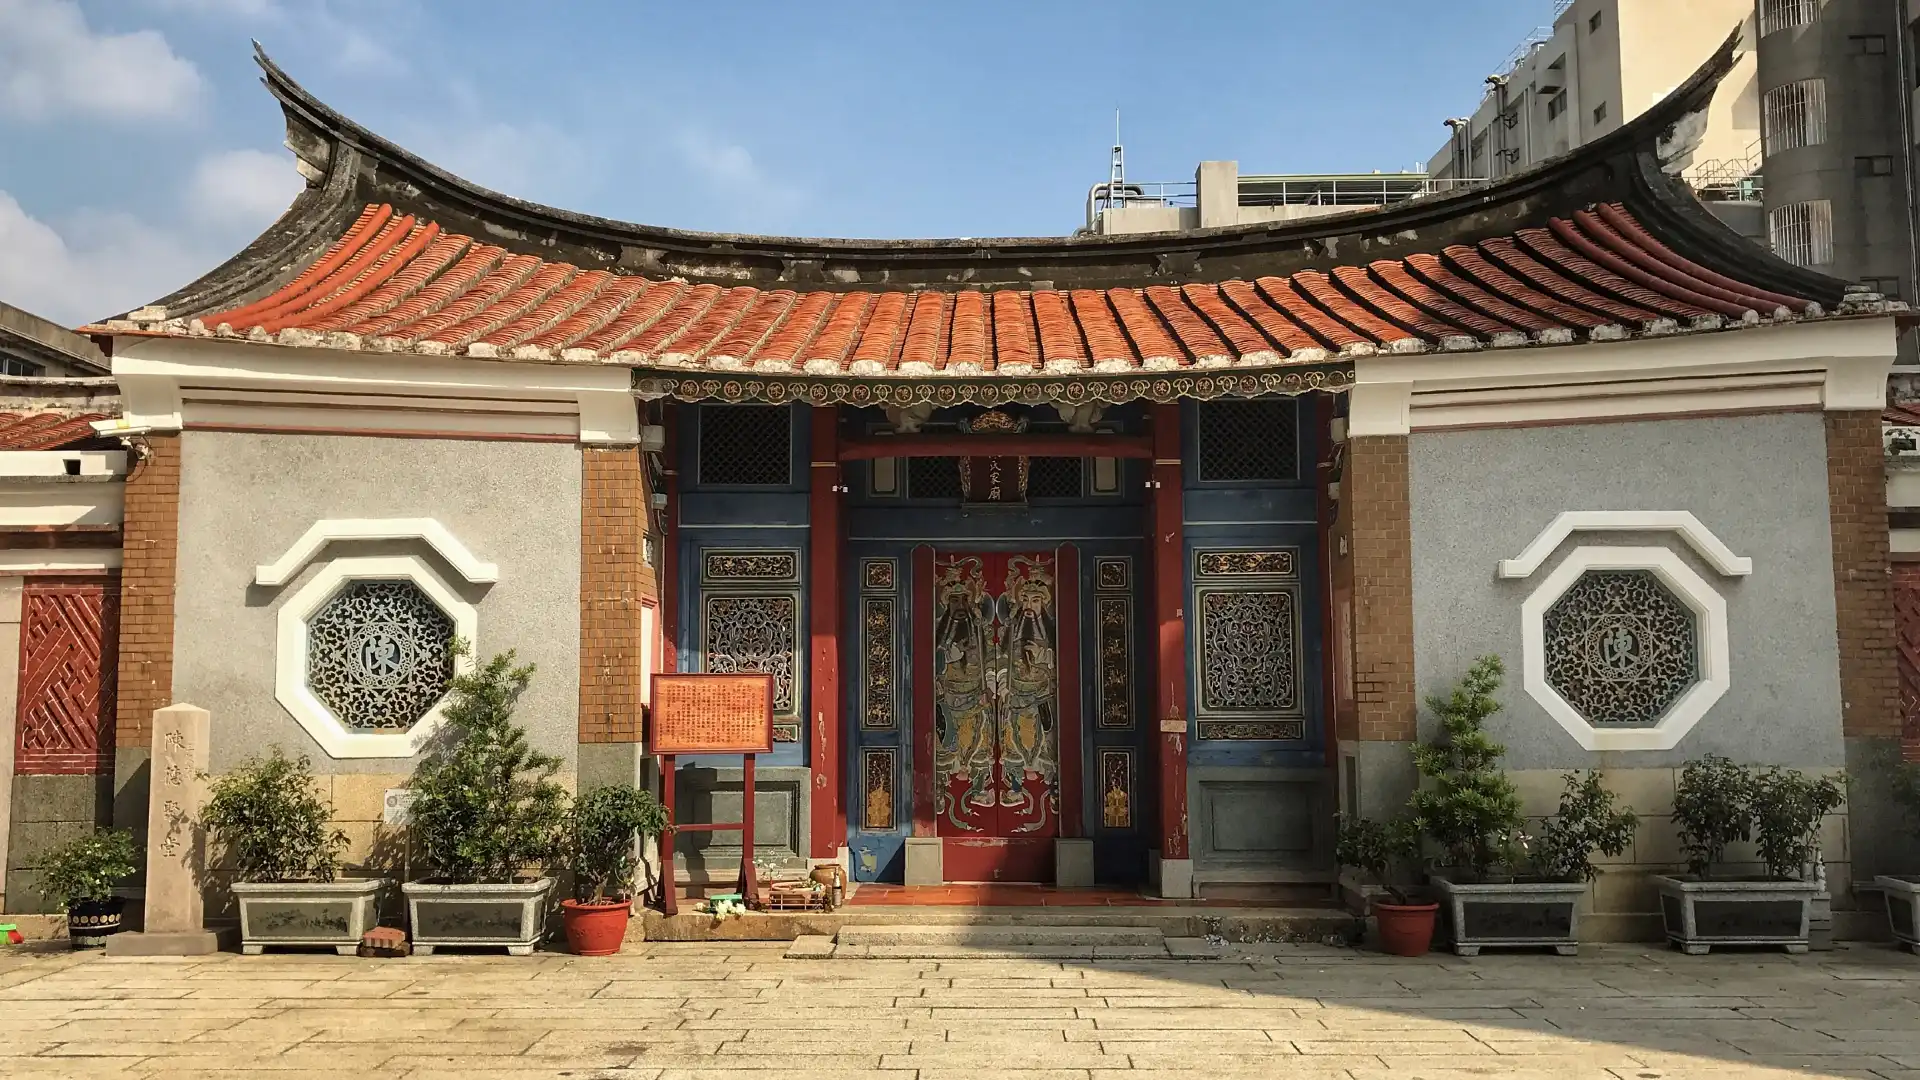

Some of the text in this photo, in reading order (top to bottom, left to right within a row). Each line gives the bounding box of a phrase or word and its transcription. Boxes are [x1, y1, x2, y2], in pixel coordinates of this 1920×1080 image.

[987, 455, 1002, 501] 氏家廟
[365, 634, 401, 677] 陳
[1604, 628, 1641, 669] 陳
